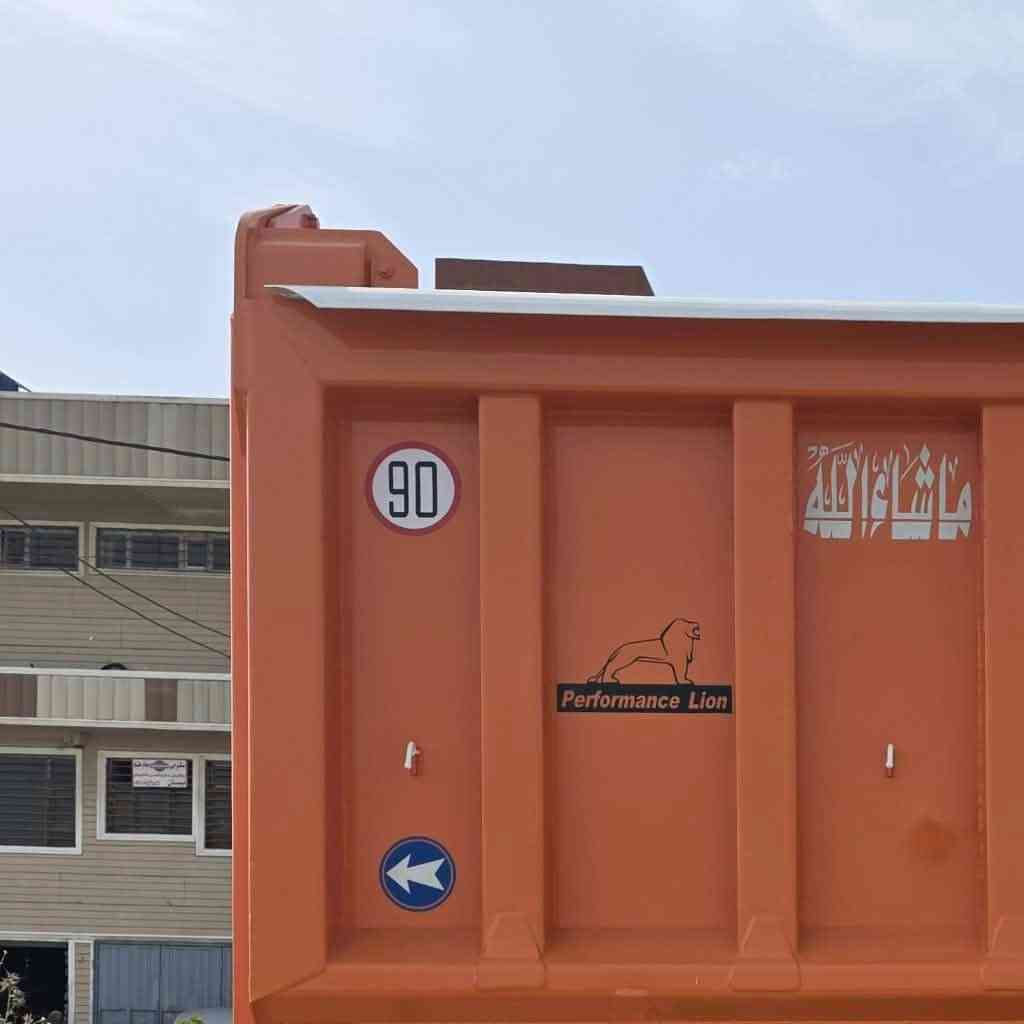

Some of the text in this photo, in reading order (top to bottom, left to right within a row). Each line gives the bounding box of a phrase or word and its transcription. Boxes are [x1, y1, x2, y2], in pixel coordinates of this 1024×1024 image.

[388, 460, 438, 518] 90
[938, 452, 972, 541] ما
[561, 690, 728, 712] Performance Lion
